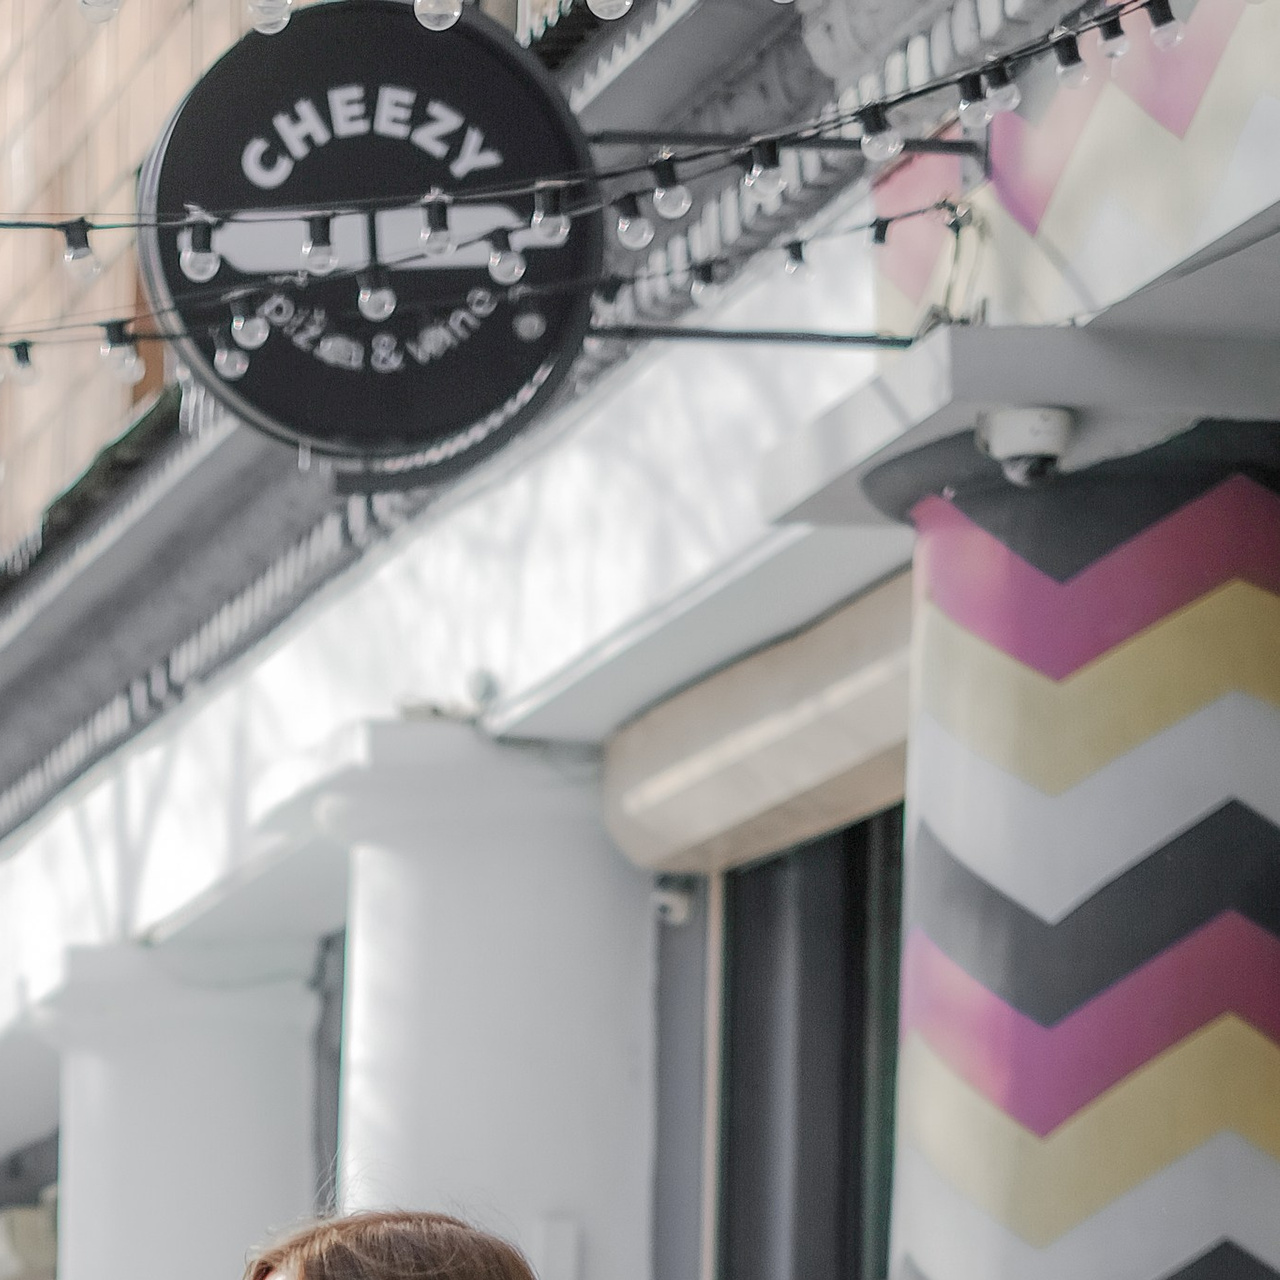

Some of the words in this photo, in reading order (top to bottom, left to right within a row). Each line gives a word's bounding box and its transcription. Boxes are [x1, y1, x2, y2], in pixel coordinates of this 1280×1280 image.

[241, 84, 503, 189] CHEEZY
[256, 294, 365, 370] piz
[371, 333, 403, 374] &
